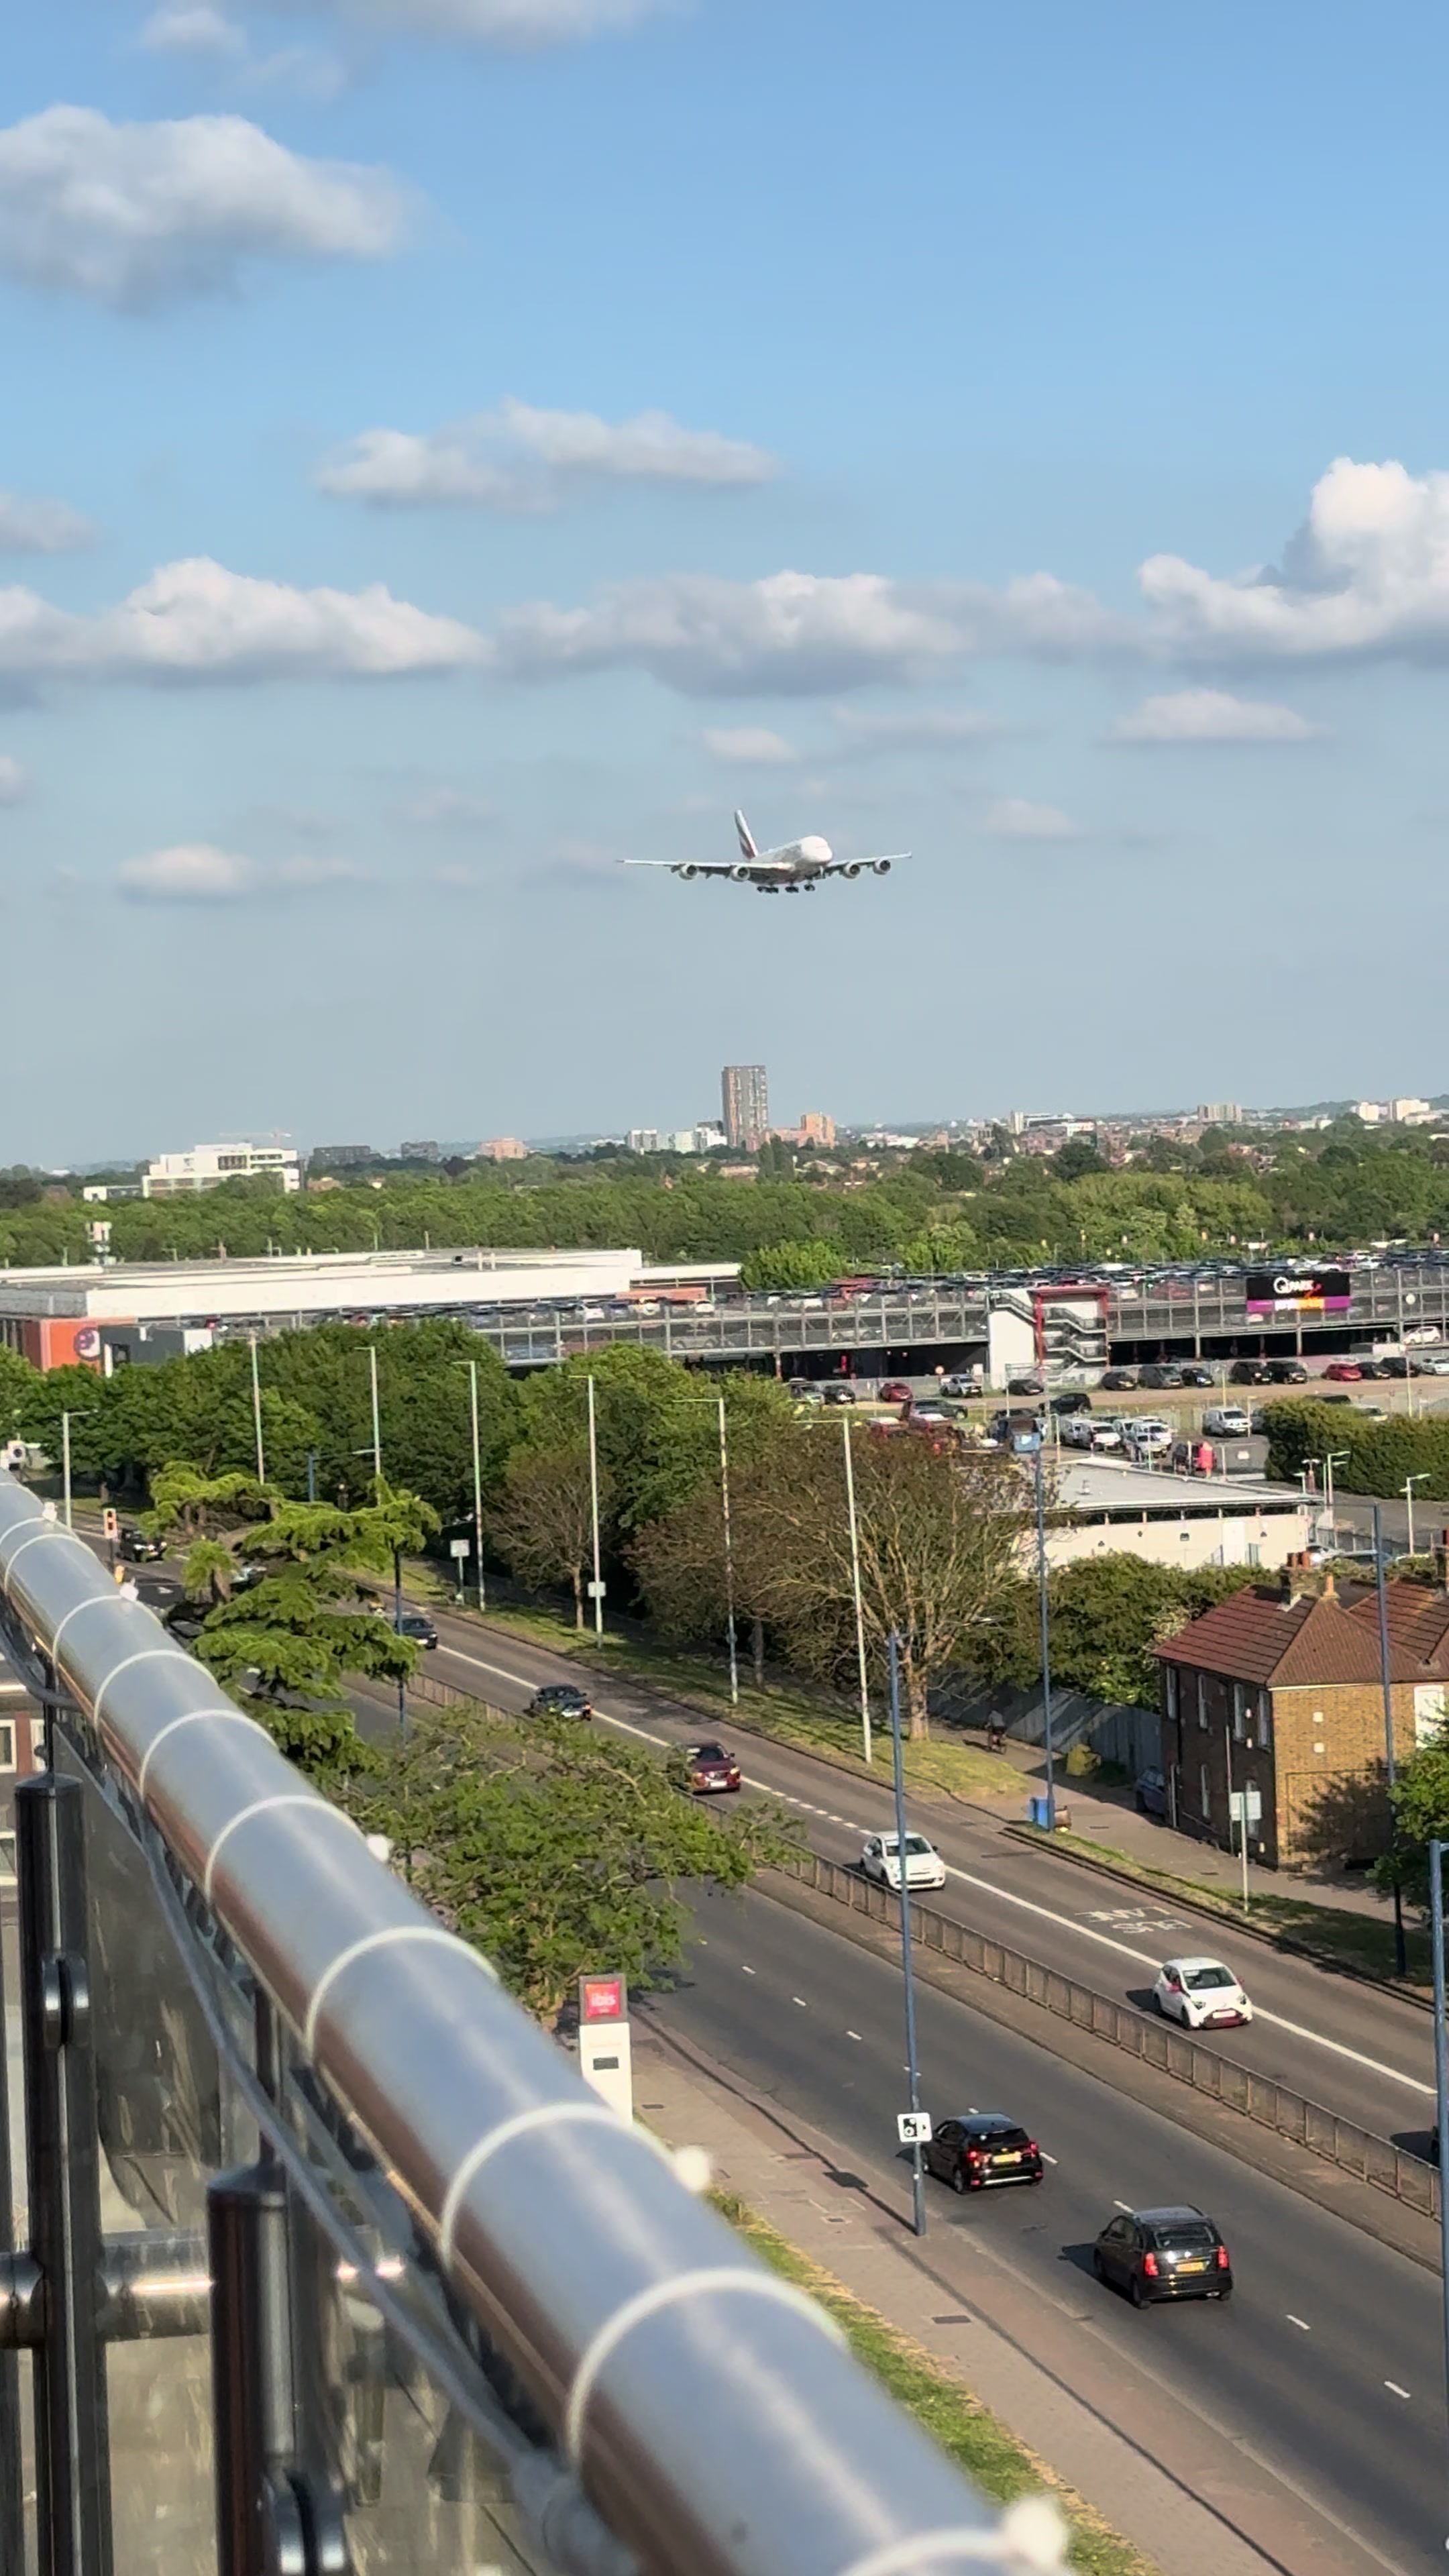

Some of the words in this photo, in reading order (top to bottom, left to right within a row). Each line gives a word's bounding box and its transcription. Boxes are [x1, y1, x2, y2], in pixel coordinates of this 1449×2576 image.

[1074, 1906, 1171, 1923] LANE
[1112, 1919, 1192, 1933] BUS
[590, 1992, 616, 2006] ibis
